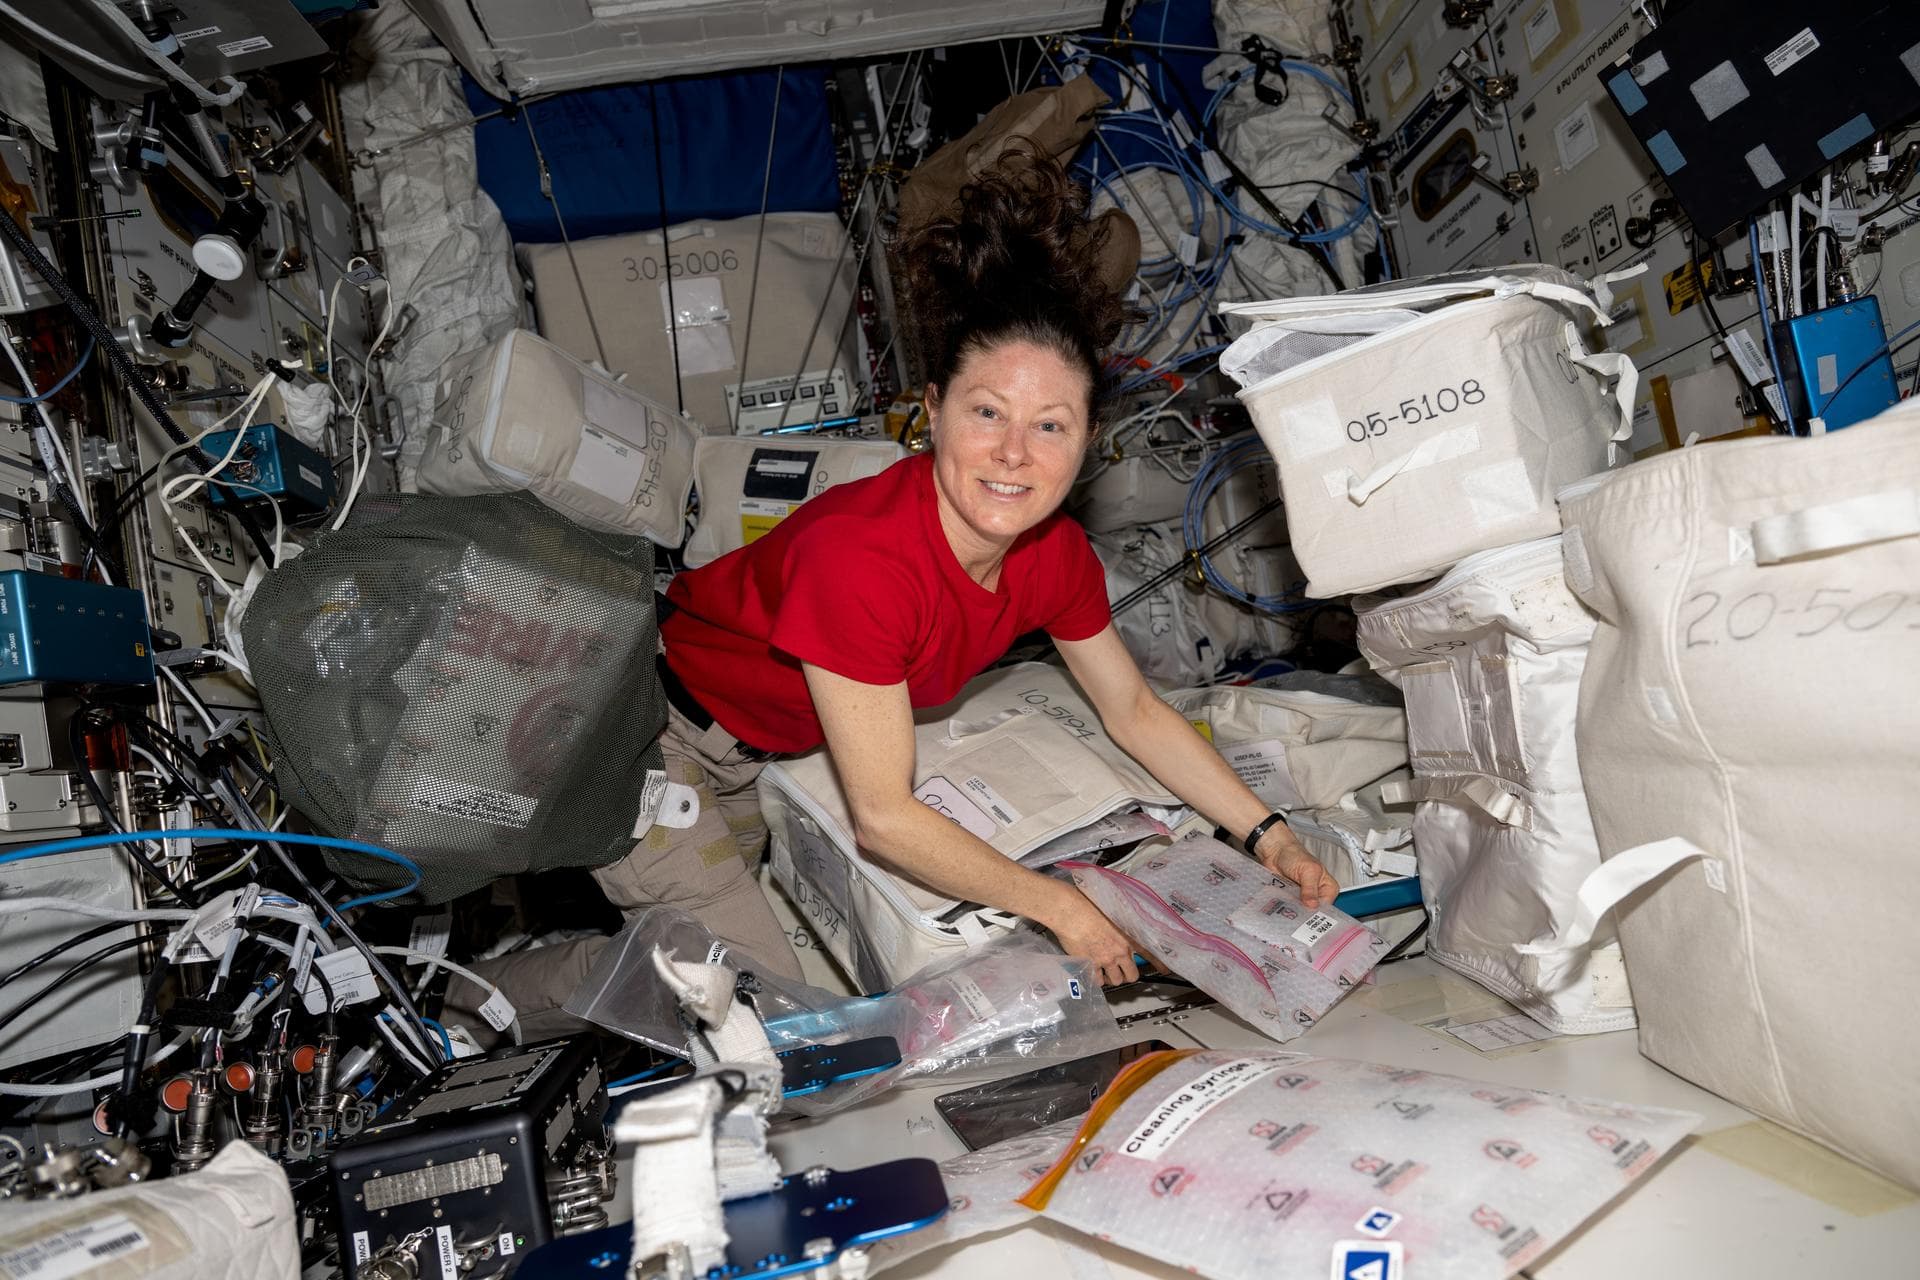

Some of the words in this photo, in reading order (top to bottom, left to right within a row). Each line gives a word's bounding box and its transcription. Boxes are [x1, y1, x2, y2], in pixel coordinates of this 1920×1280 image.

[1561, 77, 1571, 90] PU
[1571, 50, 1597, 82] UTILITY
[1599, 22, 1630, 56] DRAWER
[1436, 213, 1459, 237] PAYLOAD
[1458, 192, 1482, 217] DRAWER
[175, 255, 198, 274] PAYLO
[1685, 588, 1920, 650] 2.0-50
[1125, 1092, 1193, 1154] Cleaning
[443, 1235, 453, 1266] POWER
[502, 1237, 511, 1251] ON
